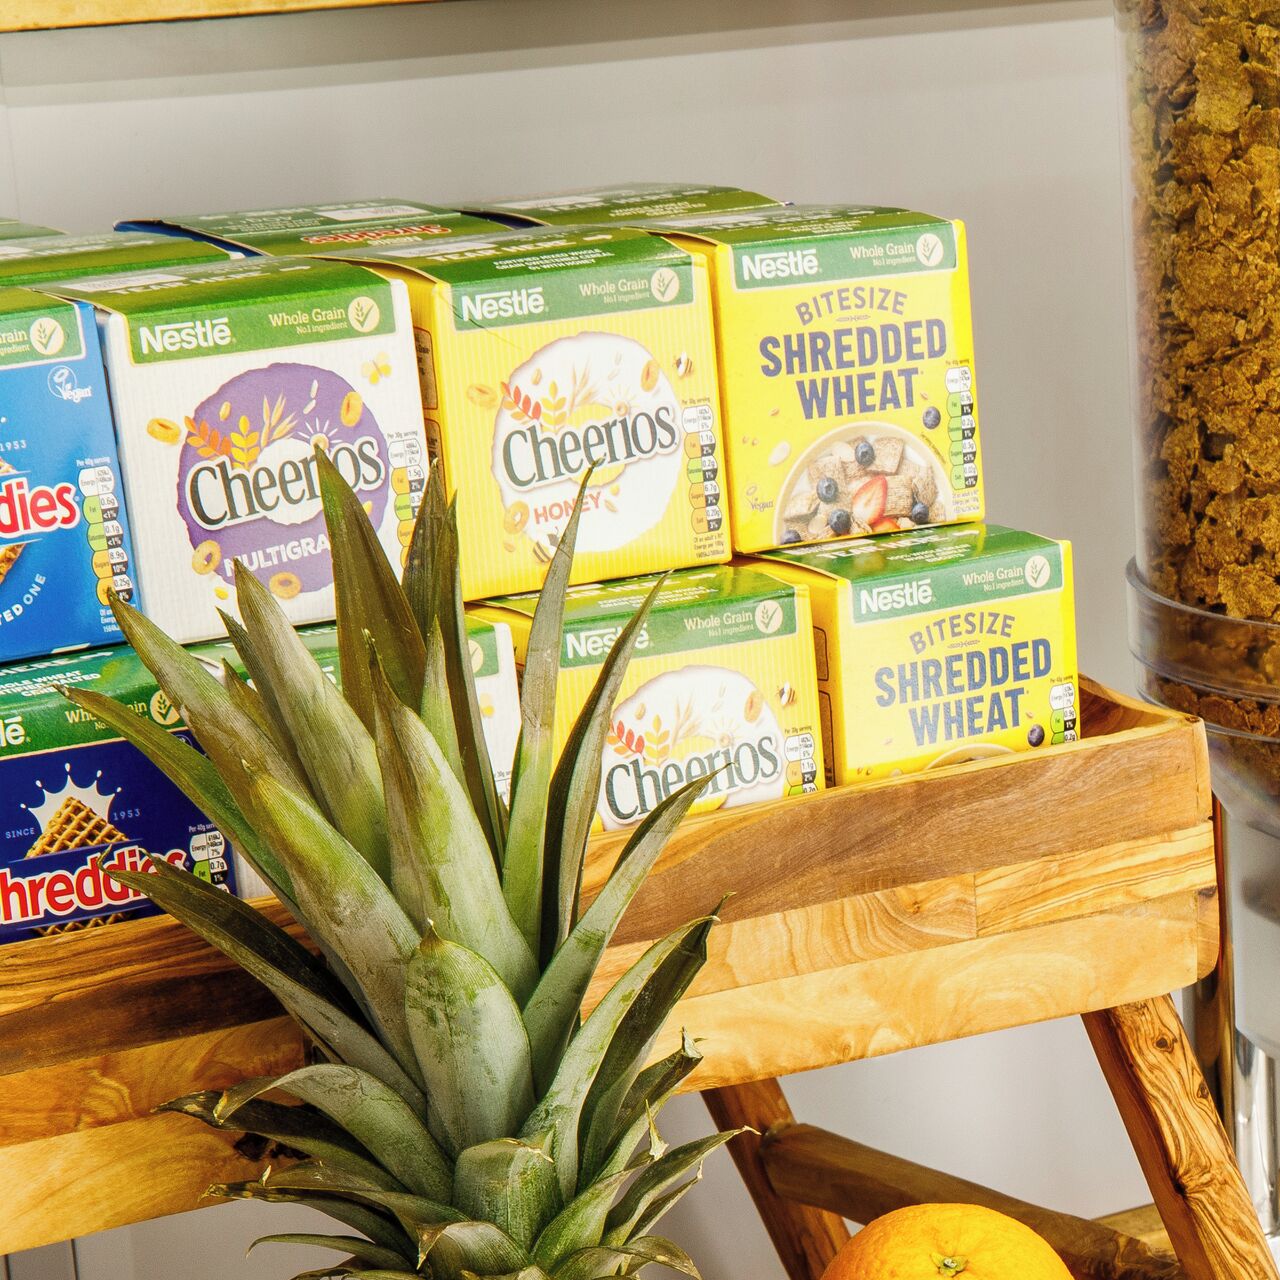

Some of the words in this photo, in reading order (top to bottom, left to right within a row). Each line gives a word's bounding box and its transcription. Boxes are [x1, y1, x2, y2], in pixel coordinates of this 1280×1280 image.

[850, 246, 884, 260] Whole
[886, 242, 914, 256] Grain
[579, 283, 615, 297] Whole
[618, 278, 648, 292] Grain
[796, 287, 908, 326] BITESIZE
[269, 312, 309, 327] Whole
[312, 307, 346, 322] Grain
[313, 321, 348, 333] ingredient
[0, 329, 28, 344] rain
[760, 318, 947, 377] SHREDDED
[796, 368, 918, 419] WHEAT
[502, 405, 677, 483] Cheerios
[190, 440, 381, 526] Cheeros
[101, 497, 115, 506] 0.6g
[106, 524, 120, 533] 0.1g
[108, 537, 121, 545] <1%
[114, 578, 130, 587] 0.25g
[963, 573, 994, 586] Whole
[996, 567, 1023, 580] Grain
[23, 573, 46, 605] ONE
[684, 616, 721, 630] Whole
[723, 612, 752, 625] Grain
[566, 622, 650, 659] Nesé
[909, 612, 1015, 655] BITESIZE
[33, 670, 82, 683] WHEAT
[874, 638, 1052, 708] SHREDDED
[909, 688, 1025, 747] WHEAT
[605, 736, 778, 820] Cheerios
[5, 827, 35, 839] SINCE
[113, 808, 141, 821] 1953
[211, 861, 224, 869] 0.7g
